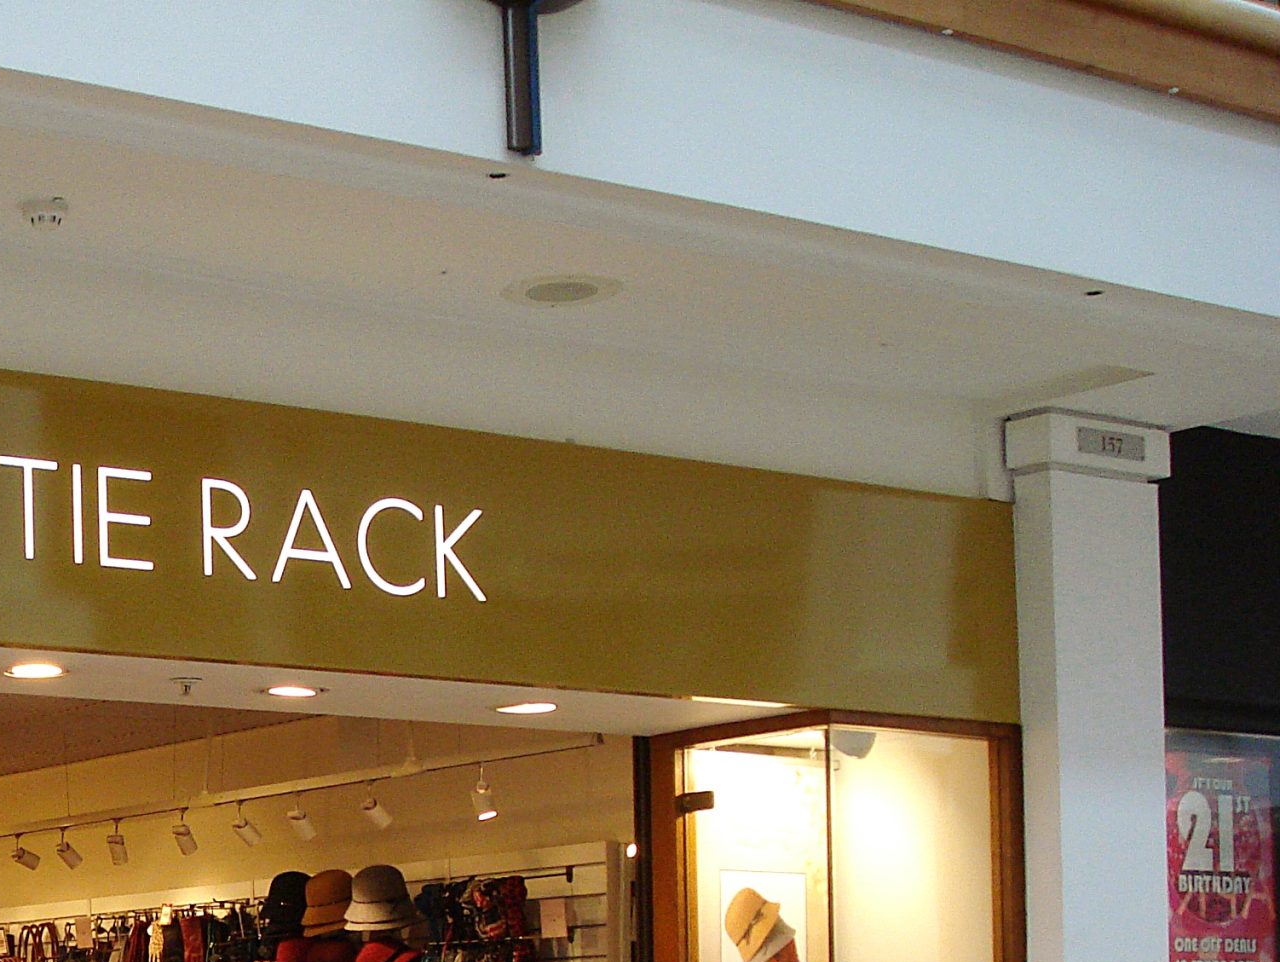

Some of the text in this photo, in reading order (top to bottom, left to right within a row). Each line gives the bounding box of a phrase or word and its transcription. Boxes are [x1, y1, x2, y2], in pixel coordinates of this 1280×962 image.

[1101, 435, 1123, 454] 157
[201, 477, 488, 603] RACK
[1178, 875, 1250, 893] BIRTHDAY
[1174, 937, 1198, 952] ONE
[1224, 938, 1257, 953] DEALS
